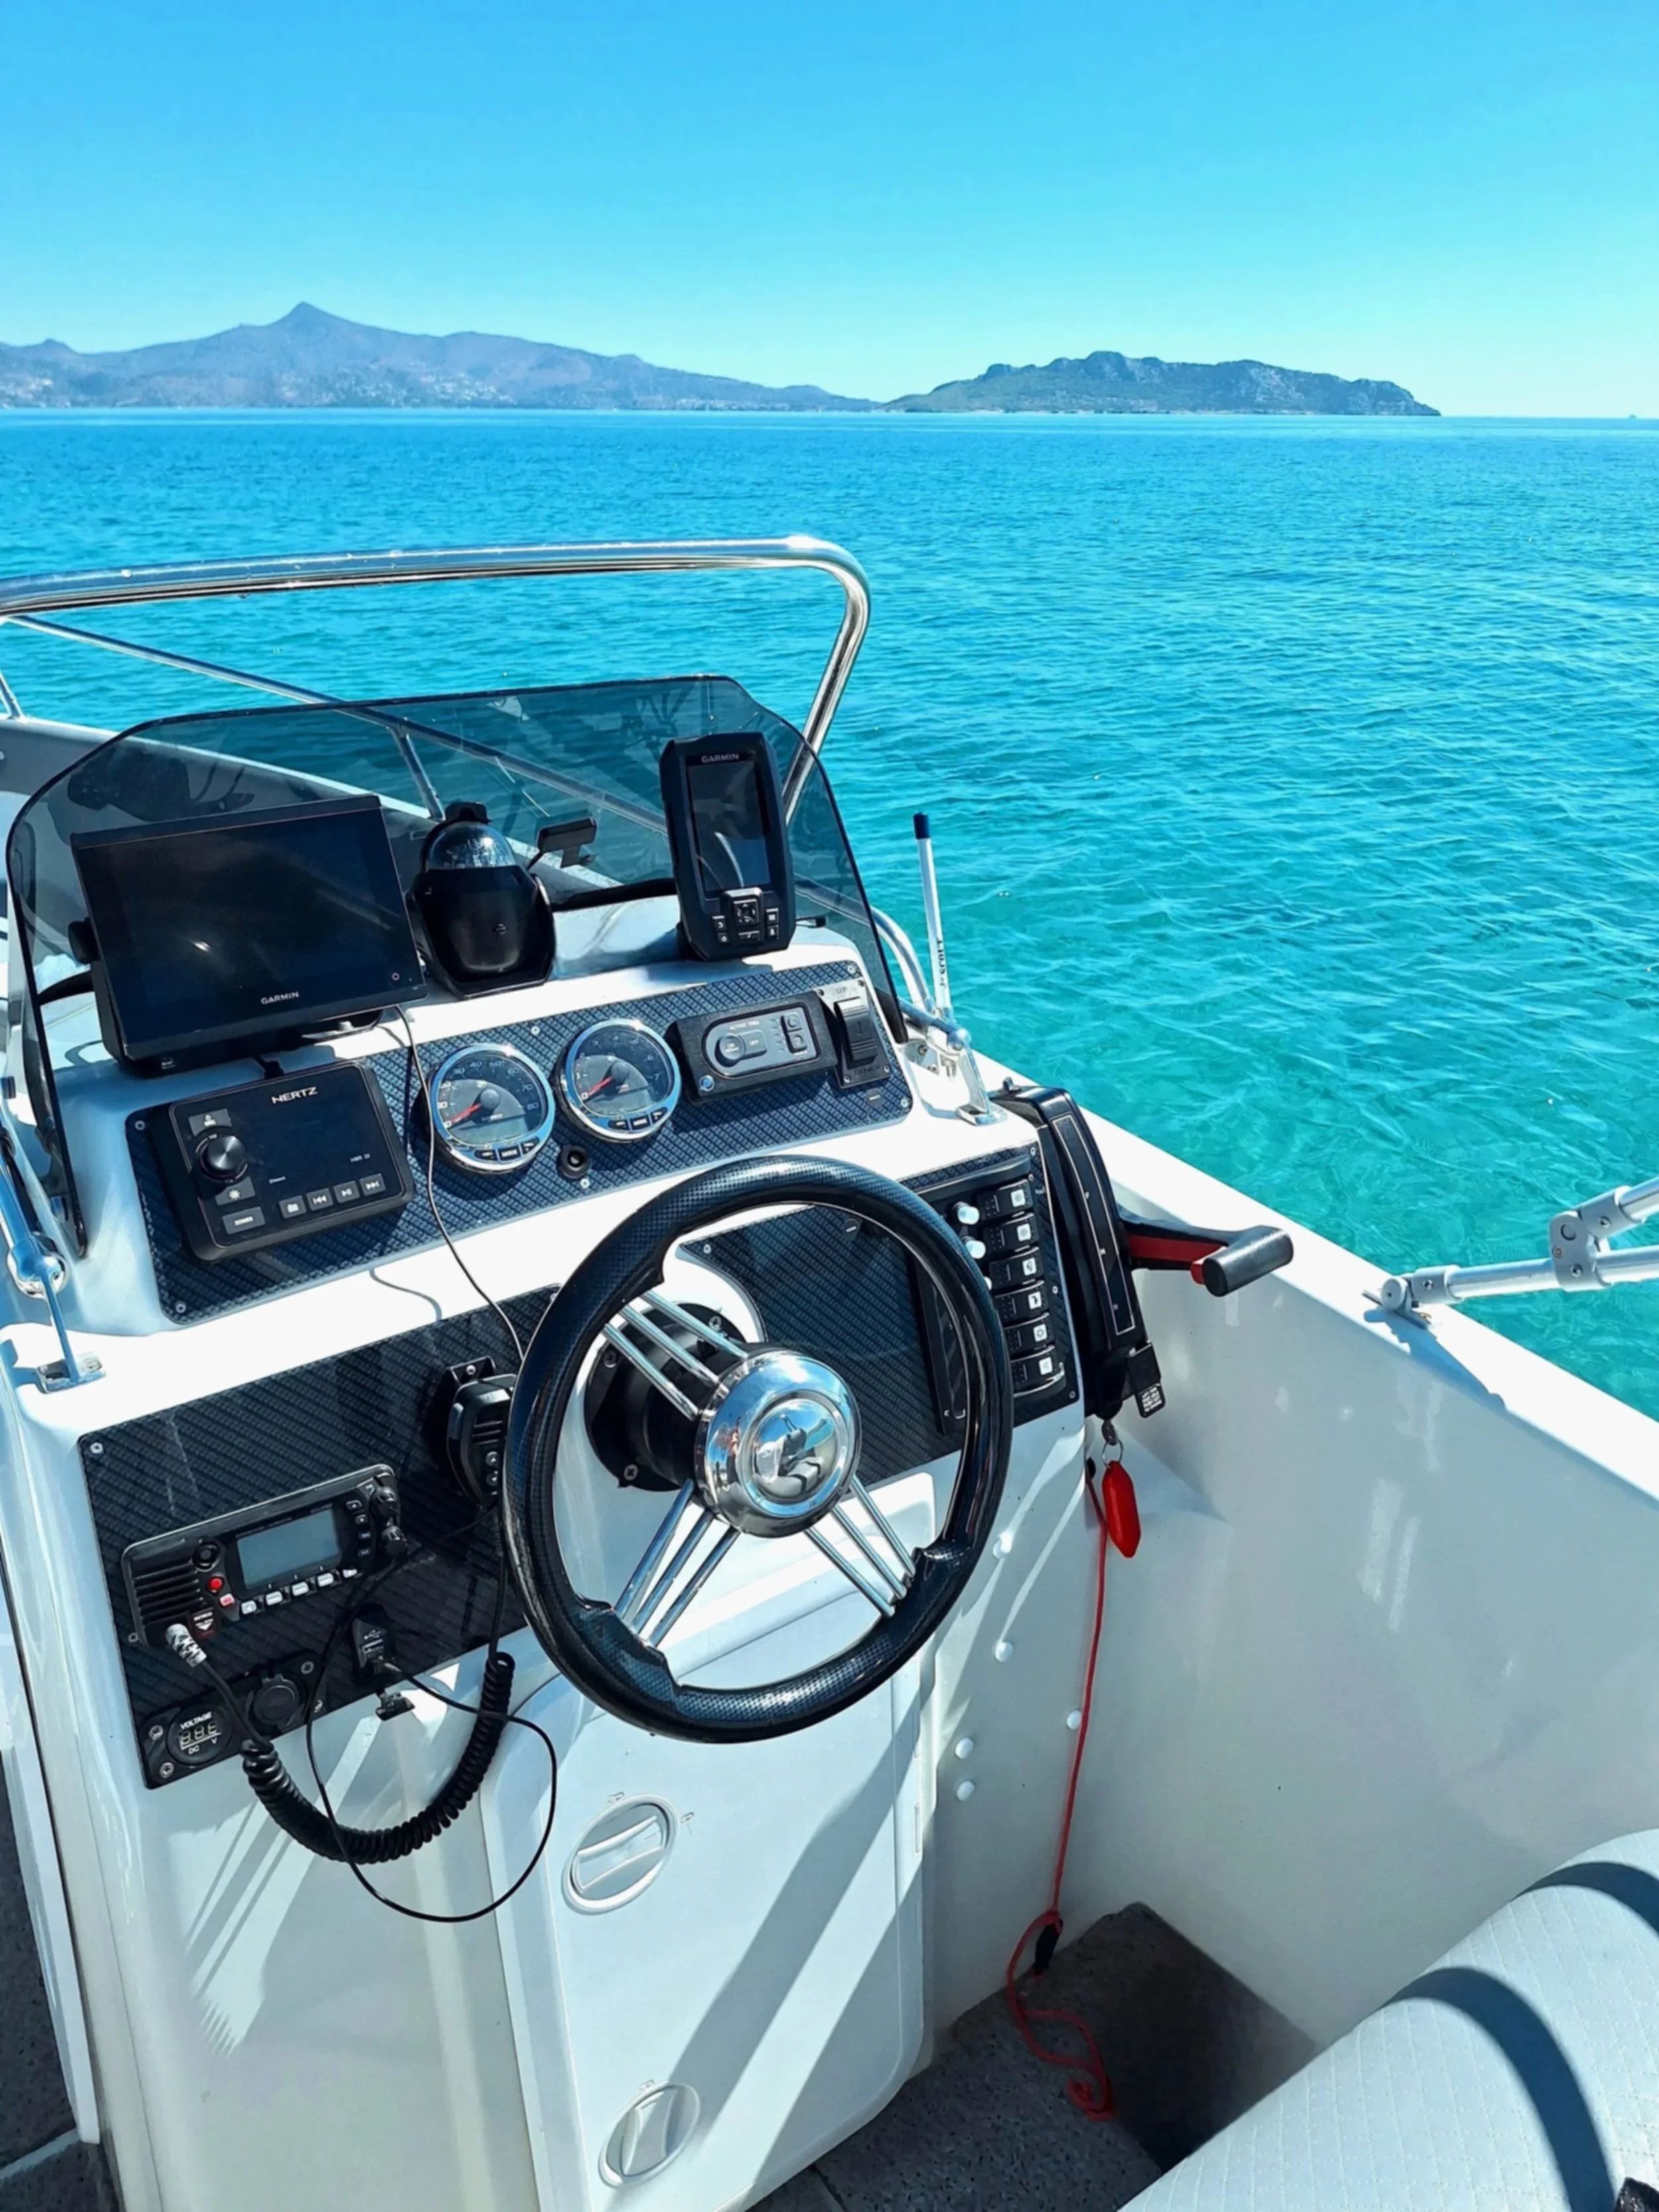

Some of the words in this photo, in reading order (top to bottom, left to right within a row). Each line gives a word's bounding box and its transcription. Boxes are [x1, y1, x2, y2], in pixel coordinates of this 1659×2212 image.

[701, 753, 739, 763] GARMIN
[835, 986, 847, 995] UP
[261, 991, 299, 1005] GARMIN
[271, 1086, 318, 1104] HERTZ
[527, 1102, 539, 1110] 80
[180, 1711, 212, 1730] VOLTAGE
[188, 1745, 200, 1755] DC
